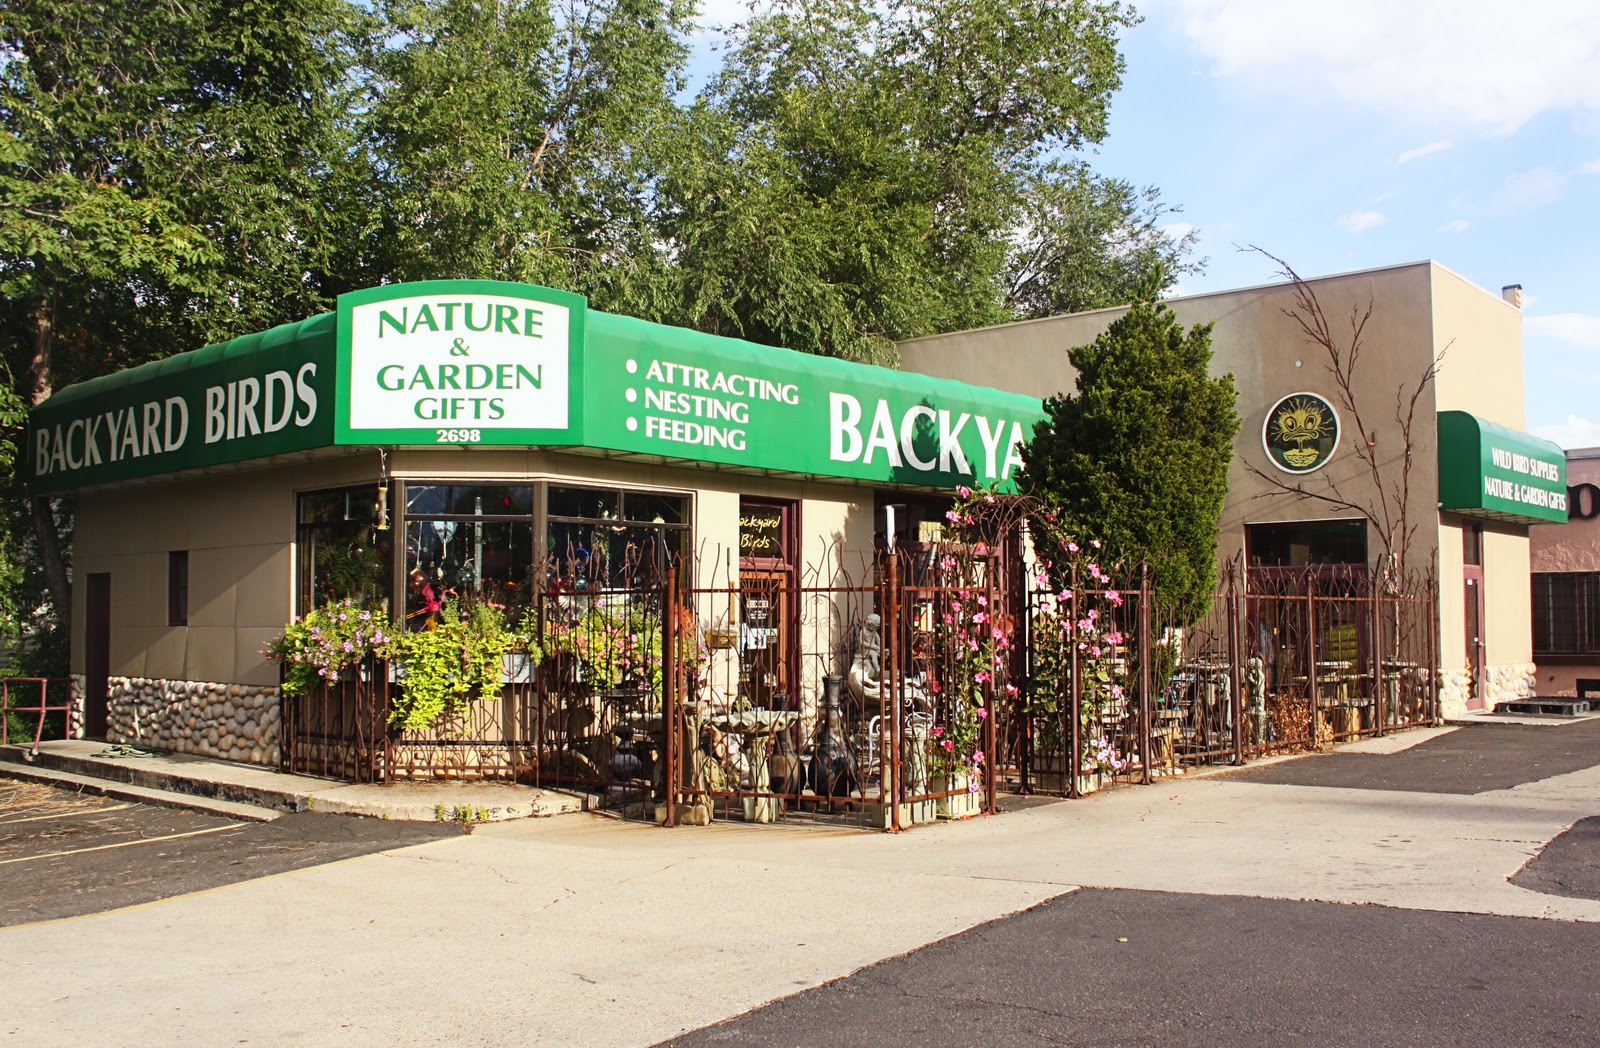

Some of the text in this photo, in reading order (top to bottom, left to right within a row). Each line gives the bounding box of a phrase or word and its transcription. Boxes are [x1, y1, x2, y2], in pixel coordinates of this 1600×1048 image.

[378, 302, 544, 339] NATURE
[449, 337, 471, 357] &
[376, 364, 542, 391] GARDEN
[645, 359, 799, 405] ATTRACTING
[35, 362, 317, 476] BACKYARD BIRDS
[413, 397, 505, 420] GIFTS
[644, 387, 749, 424] NESTING
[436, 429, 481, 443] 2698
[645, 415, 746, 451] FEEDING
[829, 391, 1028, 480] BACKYA
[1491, 447, 1559, 482] WILD BIRD SUPPLIES
[1484, 476, 1566, 511] NATURE & GARDEN GIFTS
[739, 515, 781, 533] ackyard
[740, 533, 770, 549] Birds
